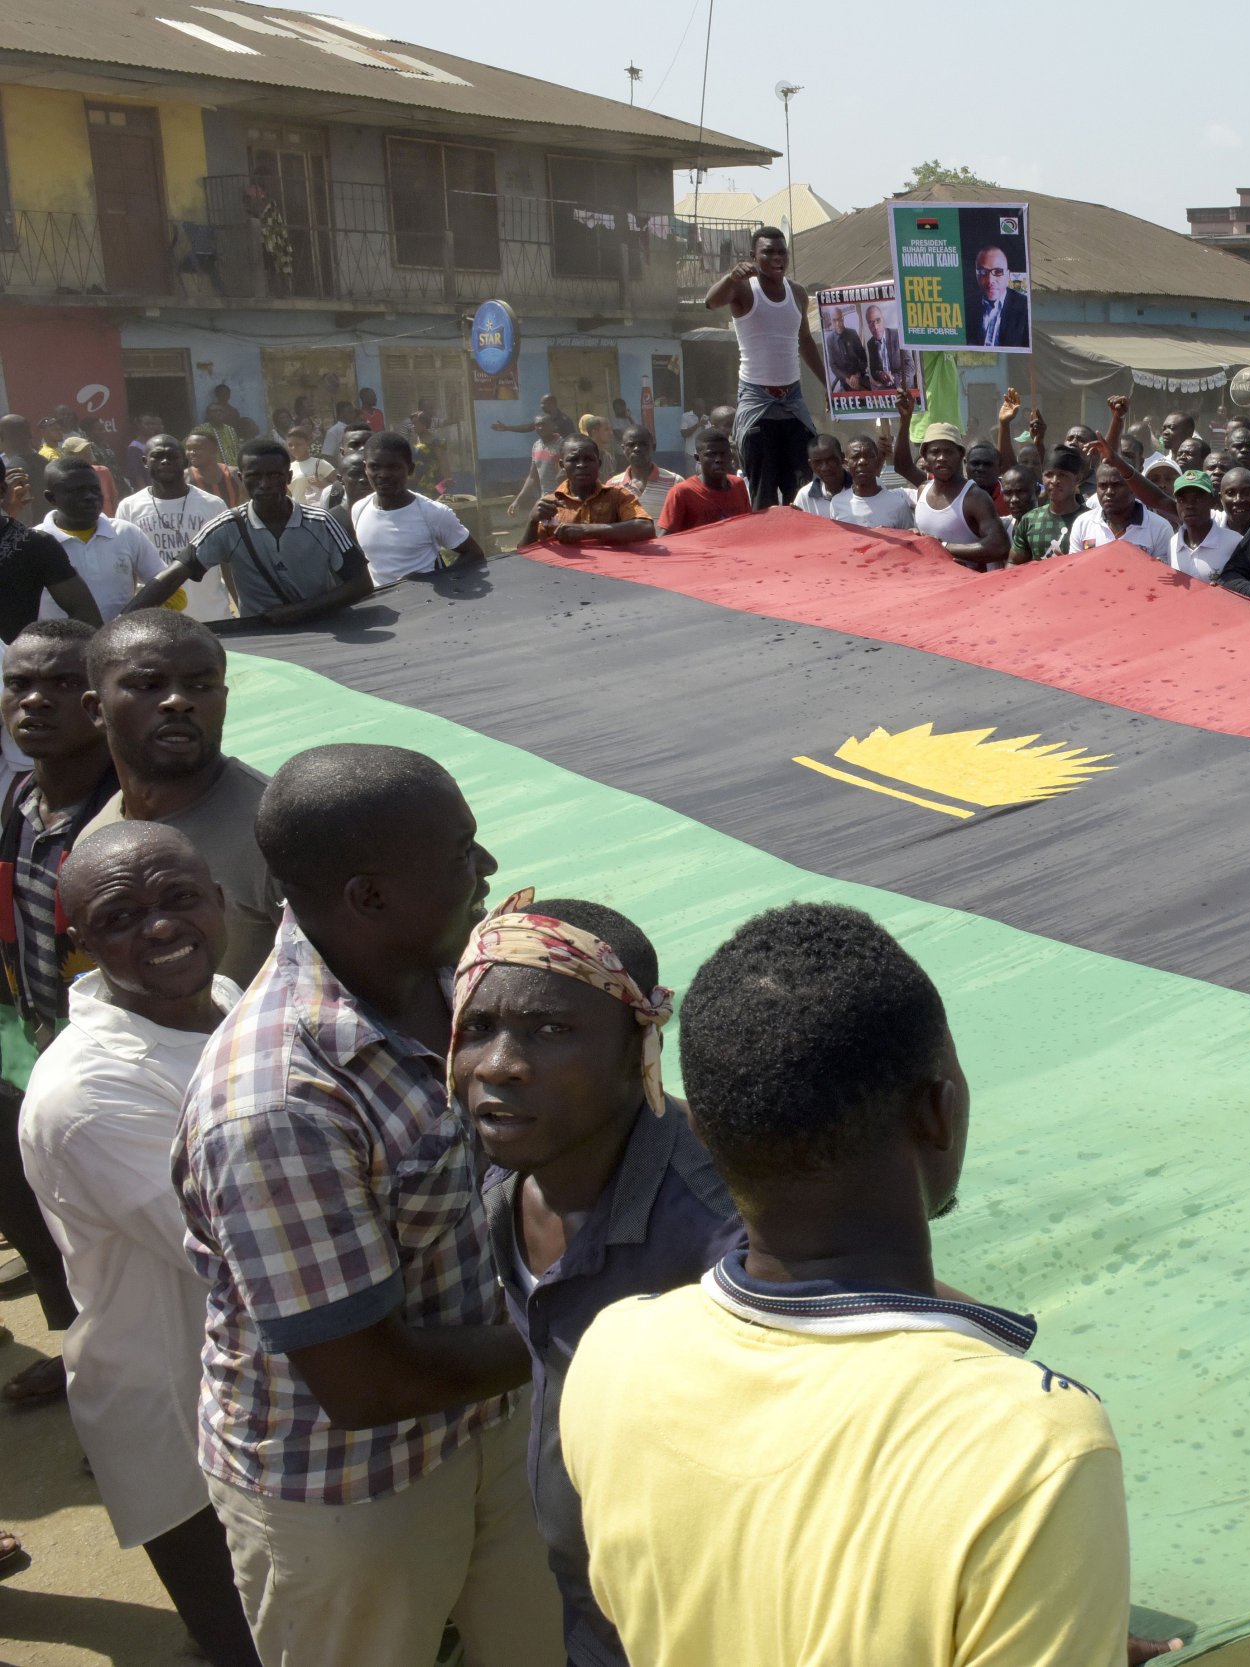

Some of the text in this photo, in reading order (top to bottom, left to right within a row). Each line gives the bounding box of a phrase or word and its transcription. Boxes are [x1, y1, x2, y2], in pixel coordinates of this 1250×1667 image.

[902, 254, 958, 267] NNAMDI KANU
[820, 286, 894, 304] FREE NNAMDI KA
[904, 276, 942, 302] FREE
[907, 303, 962, 328] BIAFRA
[479, 332, 502, 346] STAR
[833, 394, 898, 410] FREE BIAFR
[188, 514, 204, 531] NY
